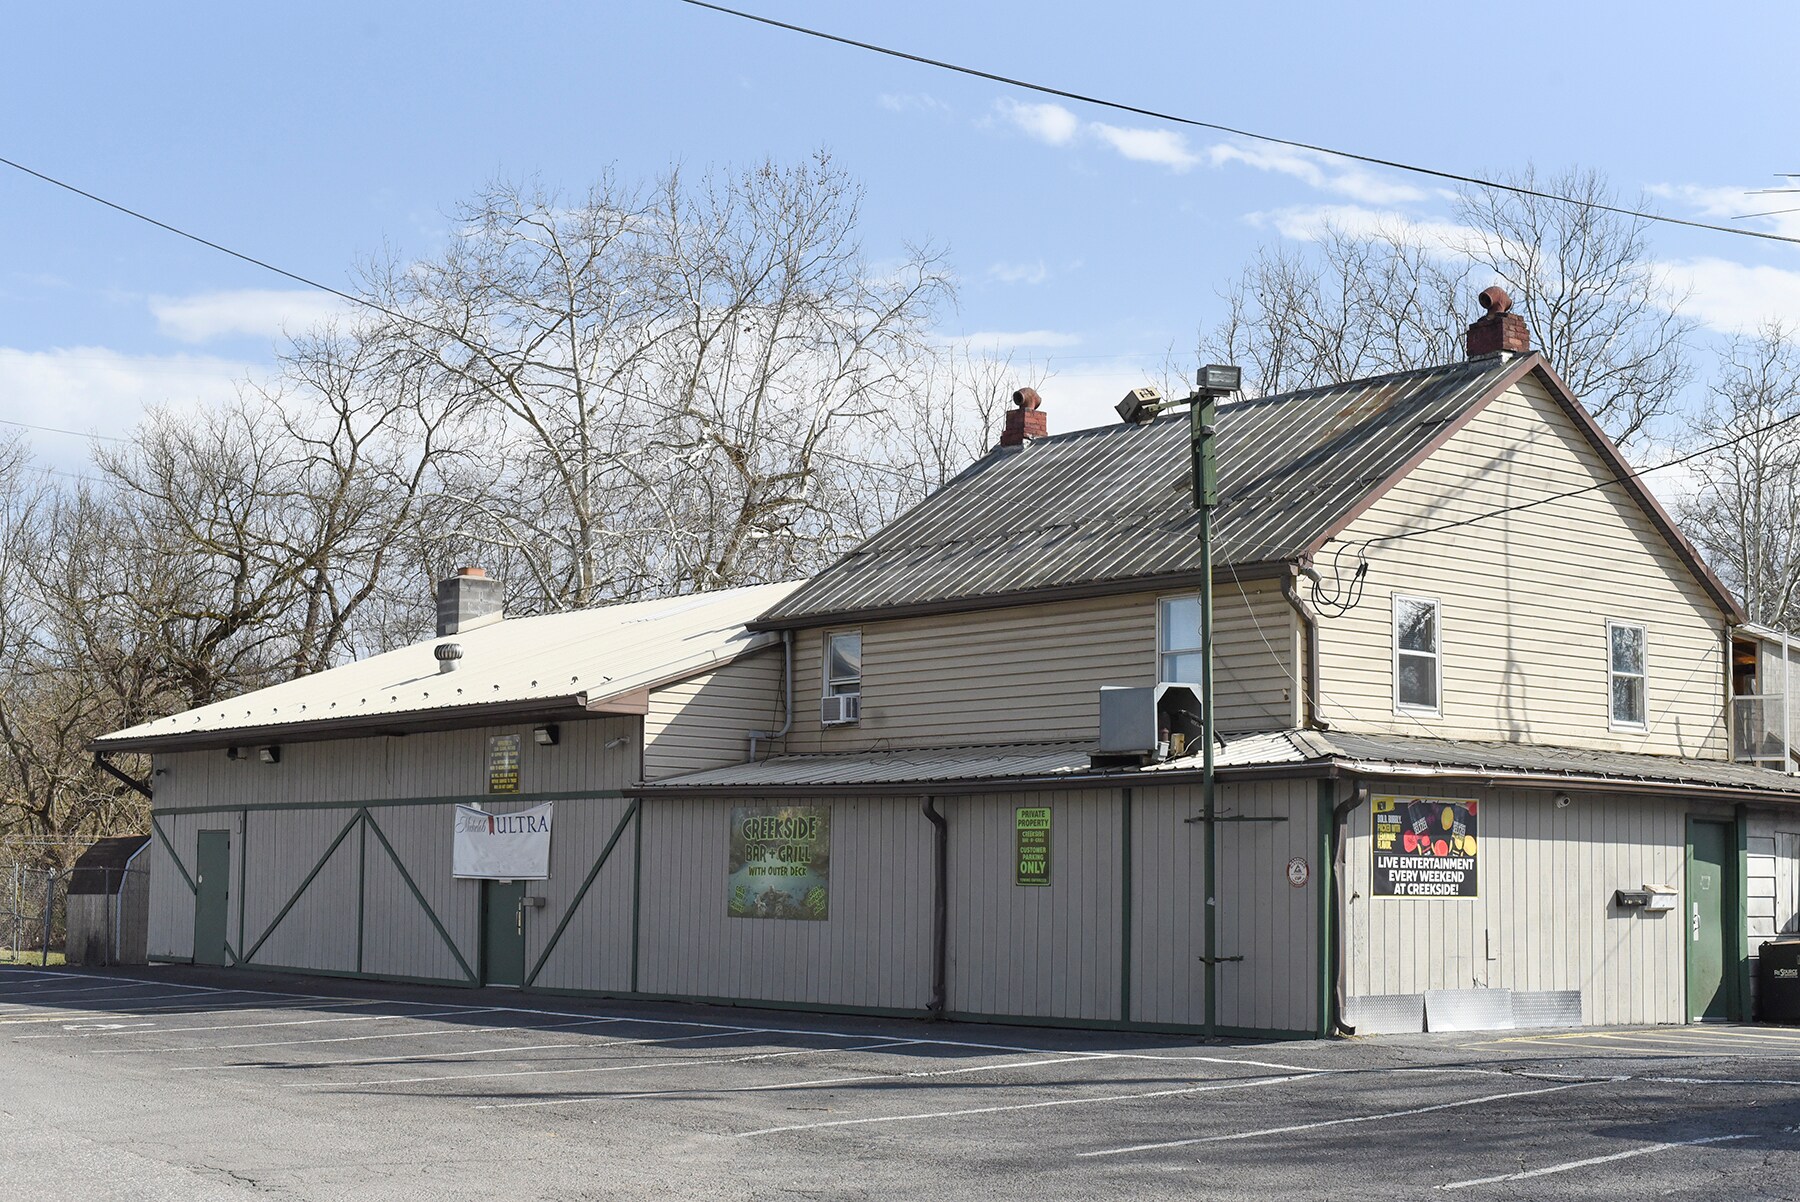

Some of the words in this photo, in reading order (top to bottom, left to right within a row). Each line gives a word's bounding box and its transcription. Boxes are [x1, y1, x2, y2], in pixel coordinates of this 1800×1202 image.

[1021, 810, 1046, 818] PRIVATE
[496, 815, 549, 834] ULTRA
[741, 816, 817, 841] CREEKSIDE
[1017, 819, 1049, 827] PROPERTY
[745, 843, 767, 863] BAR
[777, 844, 812, 864] GRILL
[1020, 861, 1046, 874] ONLY
[1378, 856, 1399, 869] LIVE
[1400, 857, 1475, 870] ENTERTAINMENT
[748, 866, 767, 877] WITH
[767, 866, 788, 877] OUTER
[789, 866, 807, 877] DECK
[1388, 870, 1418, 882] EVERY
[1420, 871, 1465, 883] WEEKEND
[1393, 883, 1407, 895] AT
[1407, 884, 1459, 896] CREEKSIDE!
